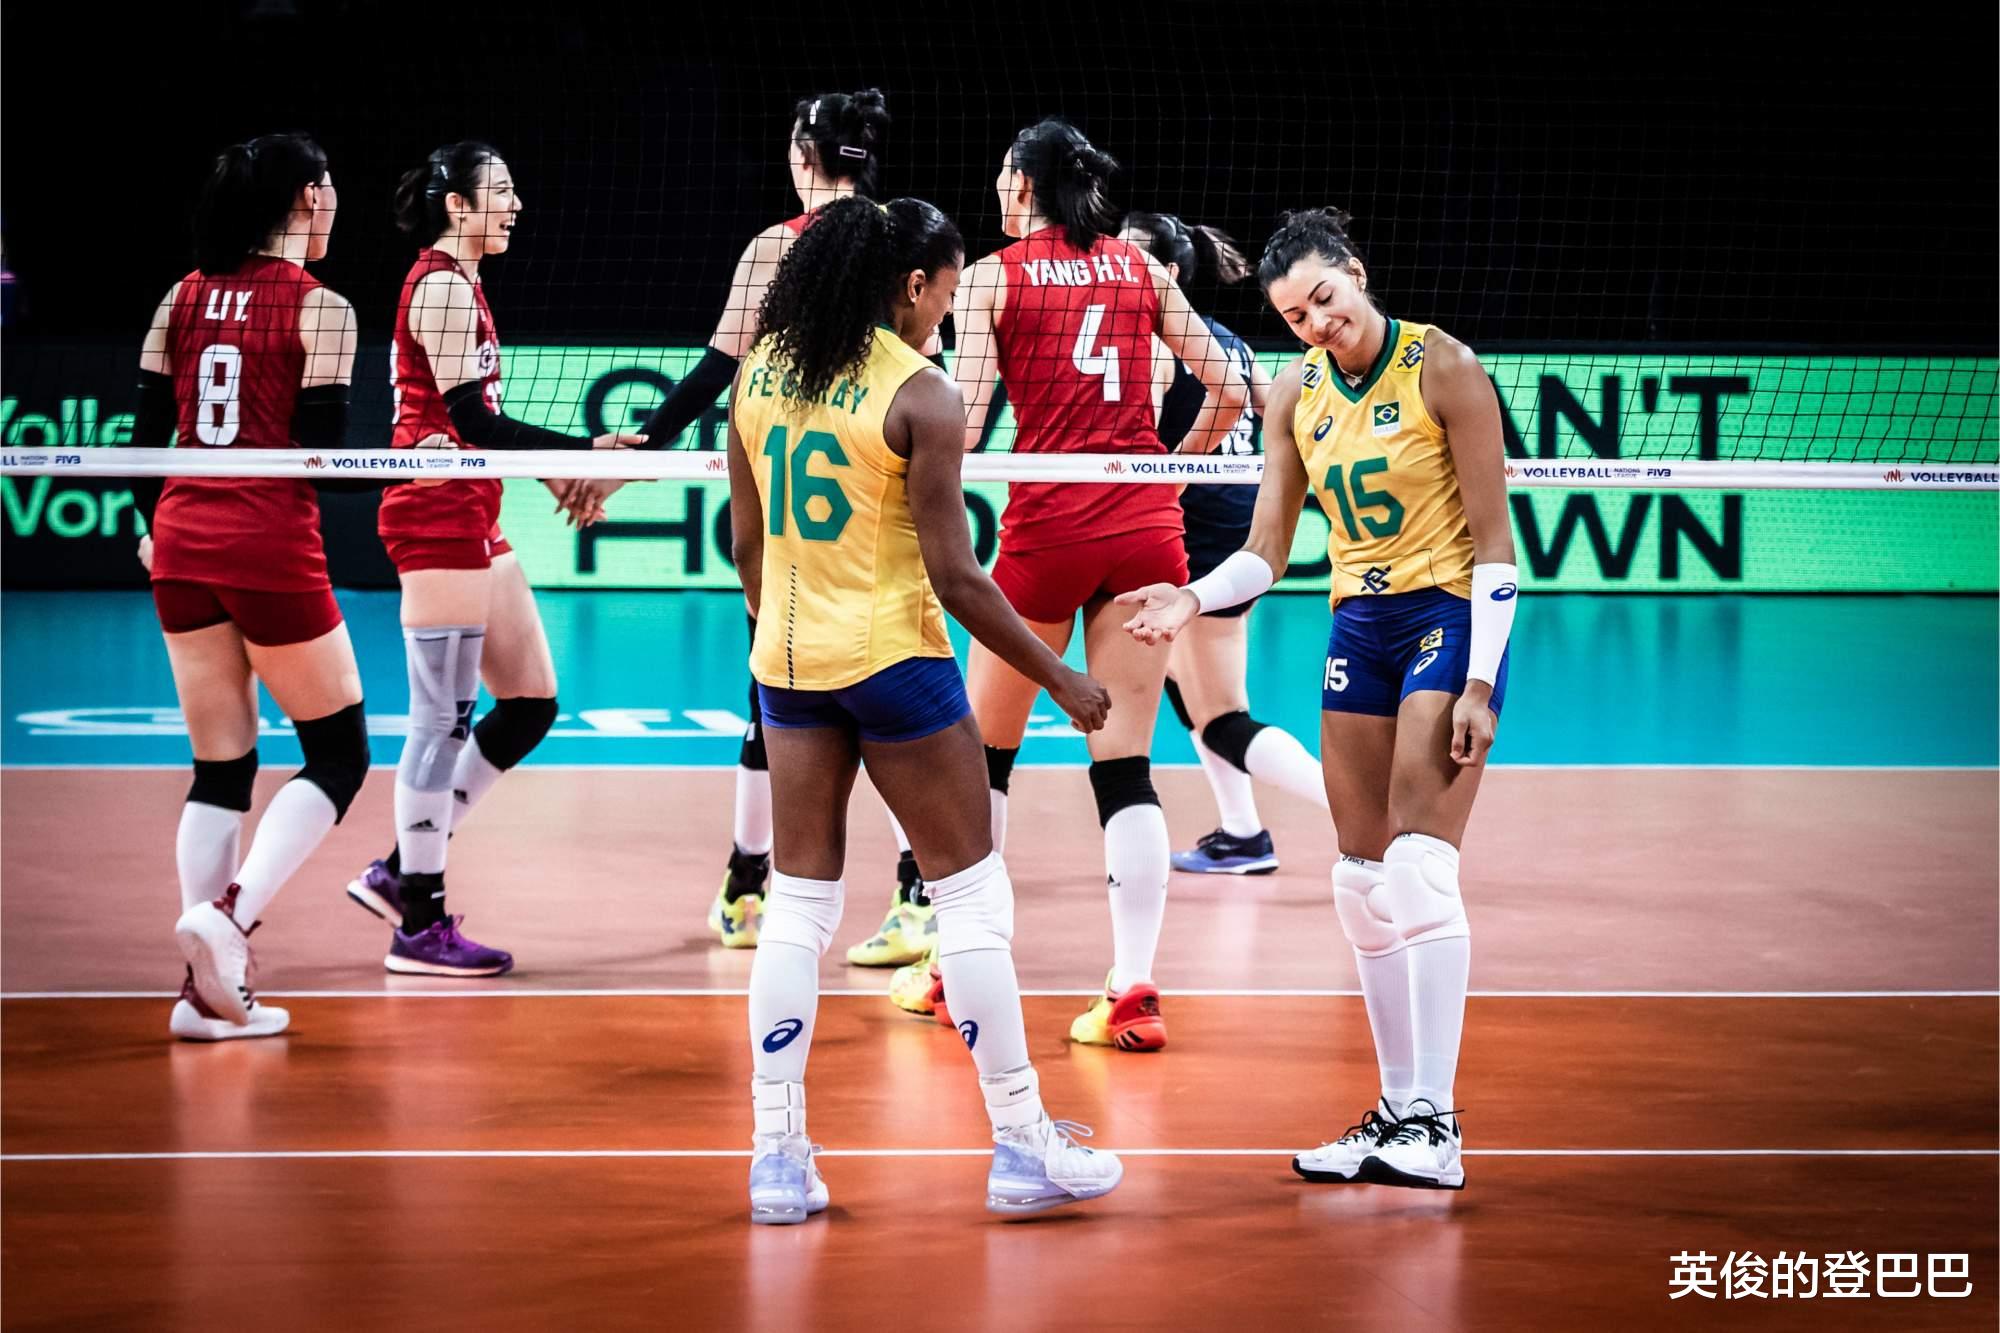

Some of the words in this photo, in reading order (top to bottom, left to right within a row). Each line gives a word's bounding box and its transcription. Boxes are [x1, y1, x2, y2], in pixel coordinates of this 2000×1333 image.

[1022, 259, 1092, 286] YANG
[1072, 304, 1121, 402] 4
[196, 344, 242, 446] 8
[332, 458, 424, 469] VOLLEYBALL
[1131, 463, 1221, 474] VOLLEYBALL
[1523, 467, 1612, 478] VOLLEYBALL
[1910, 472, 1999, 482] VOLLEYBALL
[763, 425, 853, 541] 16
[1324, 456, 1406, 541] 15
[1324, 656, 1350, 692] 15
